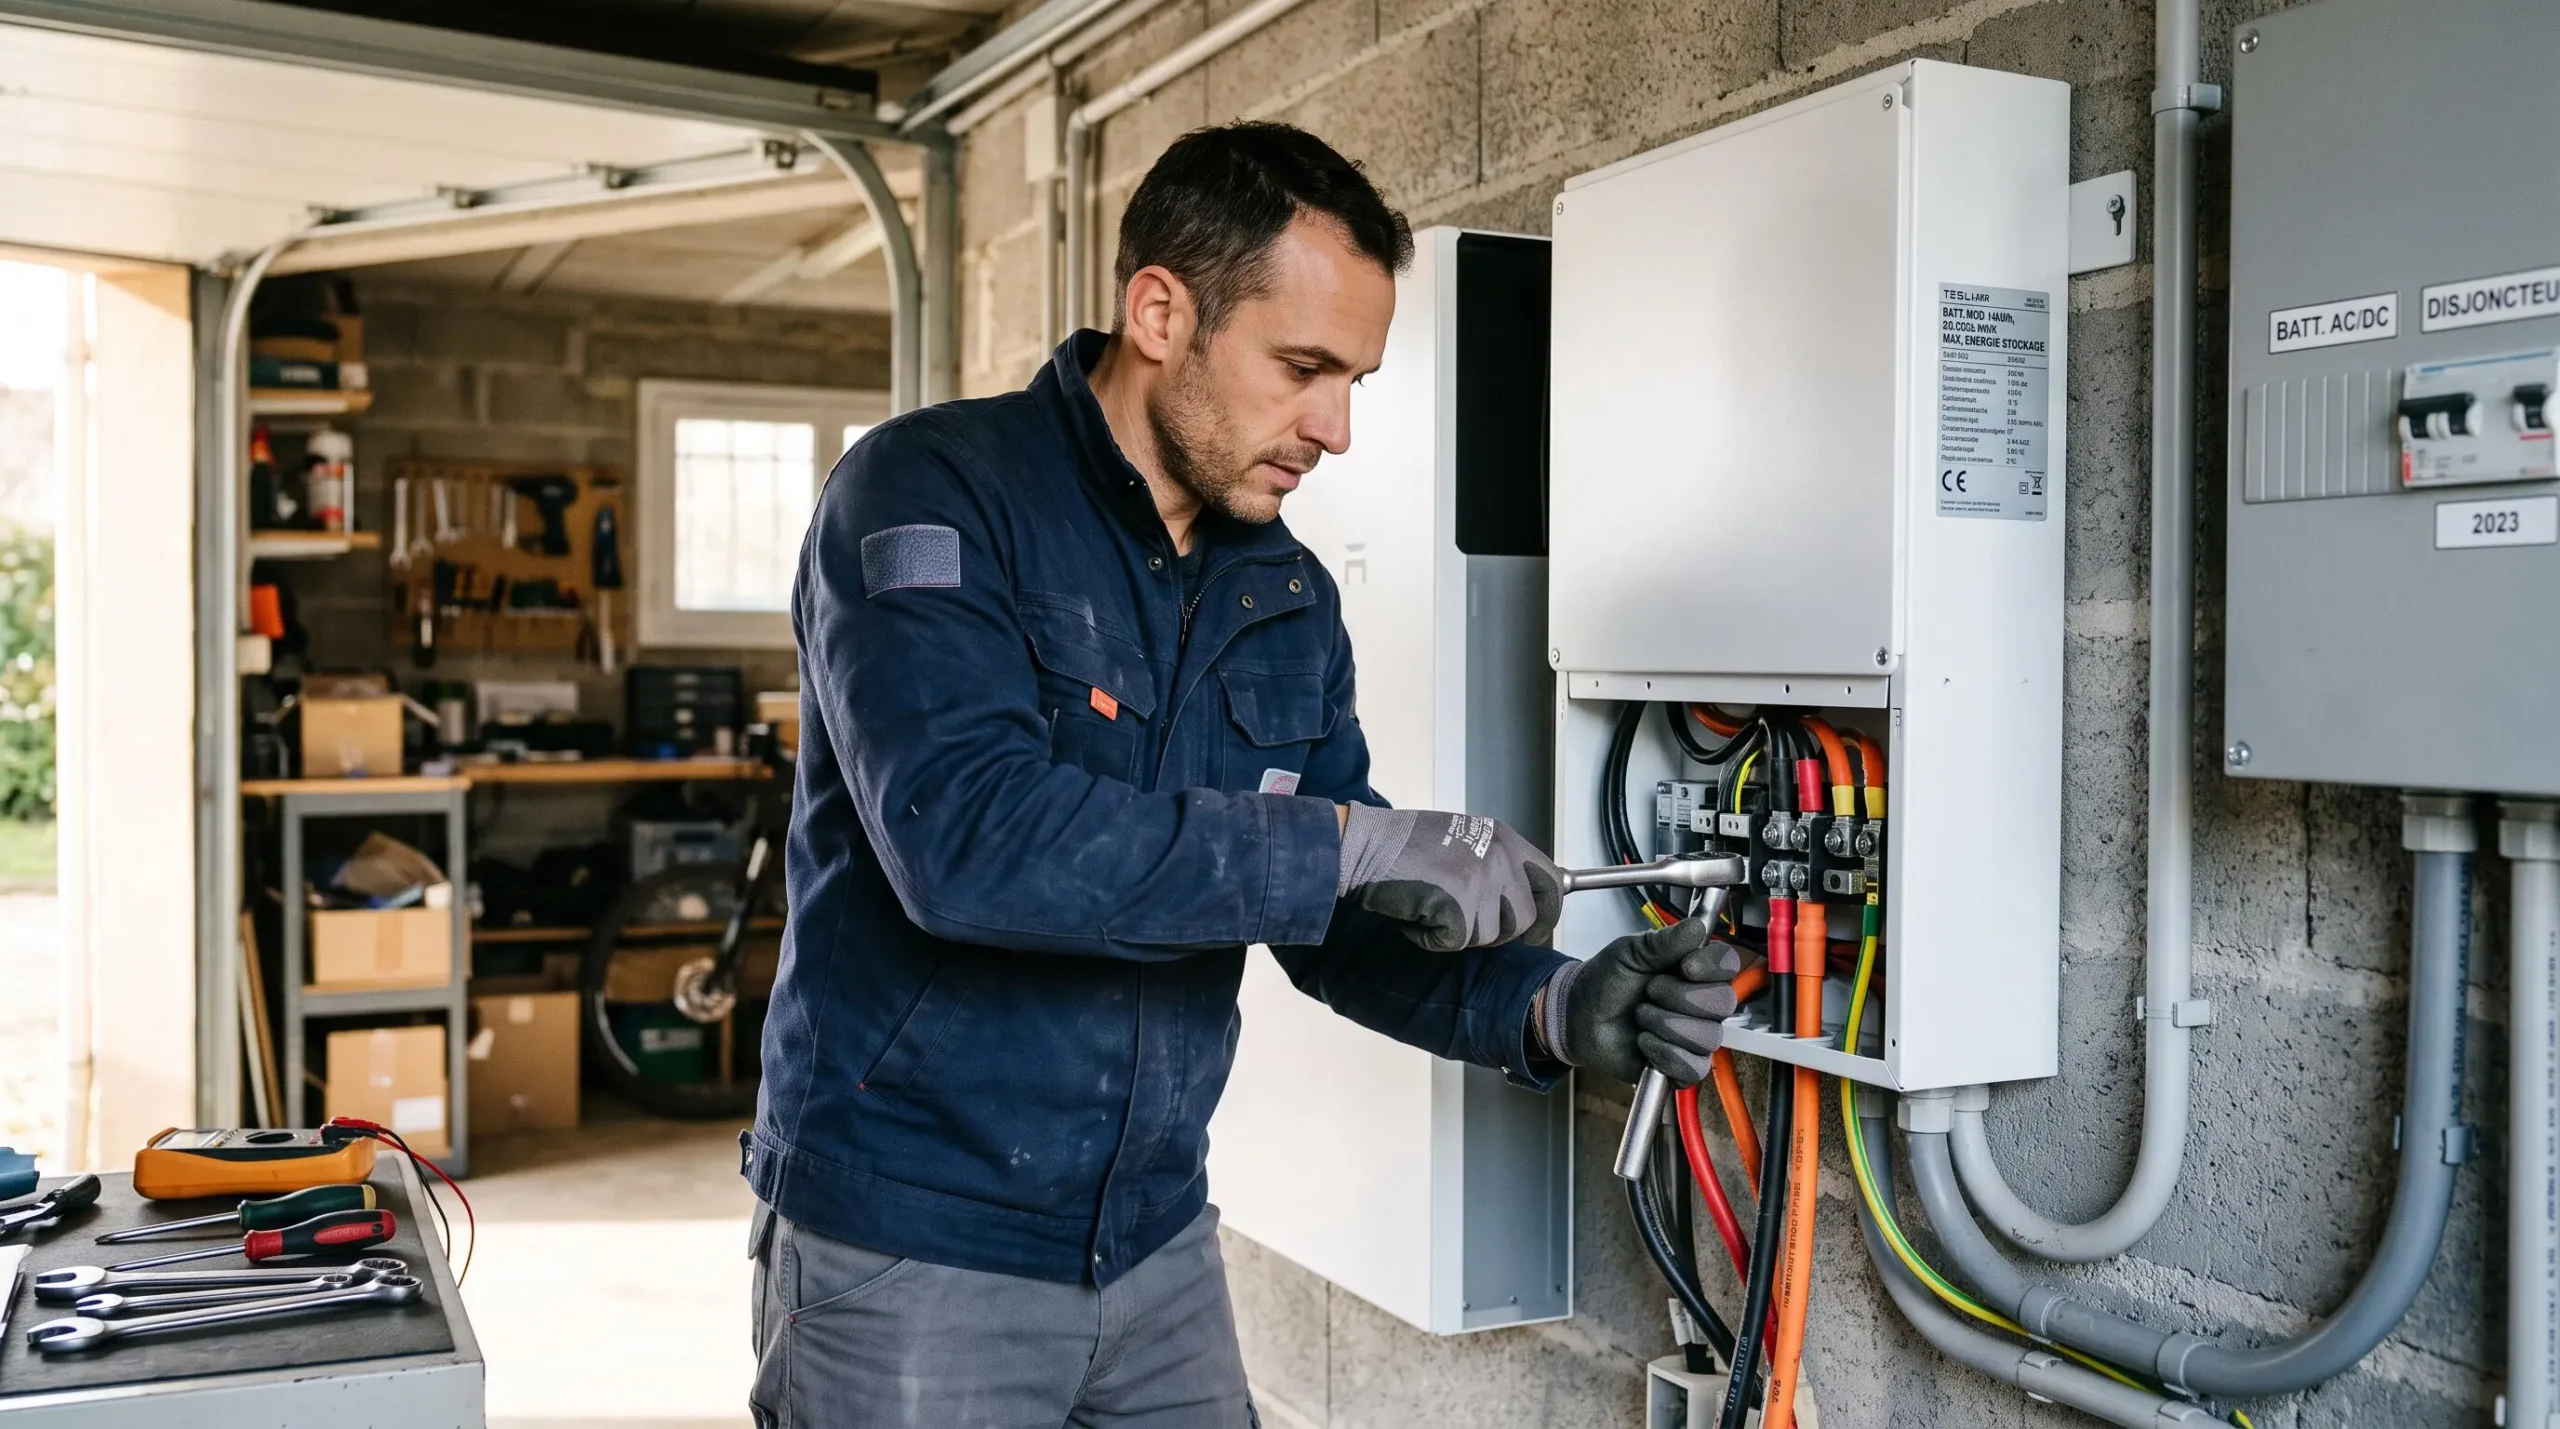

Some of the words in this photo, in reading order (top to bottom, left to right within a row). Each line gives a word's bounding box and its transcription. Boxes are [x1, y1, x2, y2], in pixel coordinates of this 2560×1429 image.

[1943, 307, 1965, 319] BATT.
[1966, 311, 1985, 321] MOD
[2277, 316, 2326, 341] BATT.
[2330, 305, 2390, 333] AC/DC
[1943, 333, 1964, 347] MAX,
[1965, 335, 2001, 348] ENERGIE
[2002, 339, 2045, 352] STOCKAGE
[2472, 511, 2520, 535] 2023
